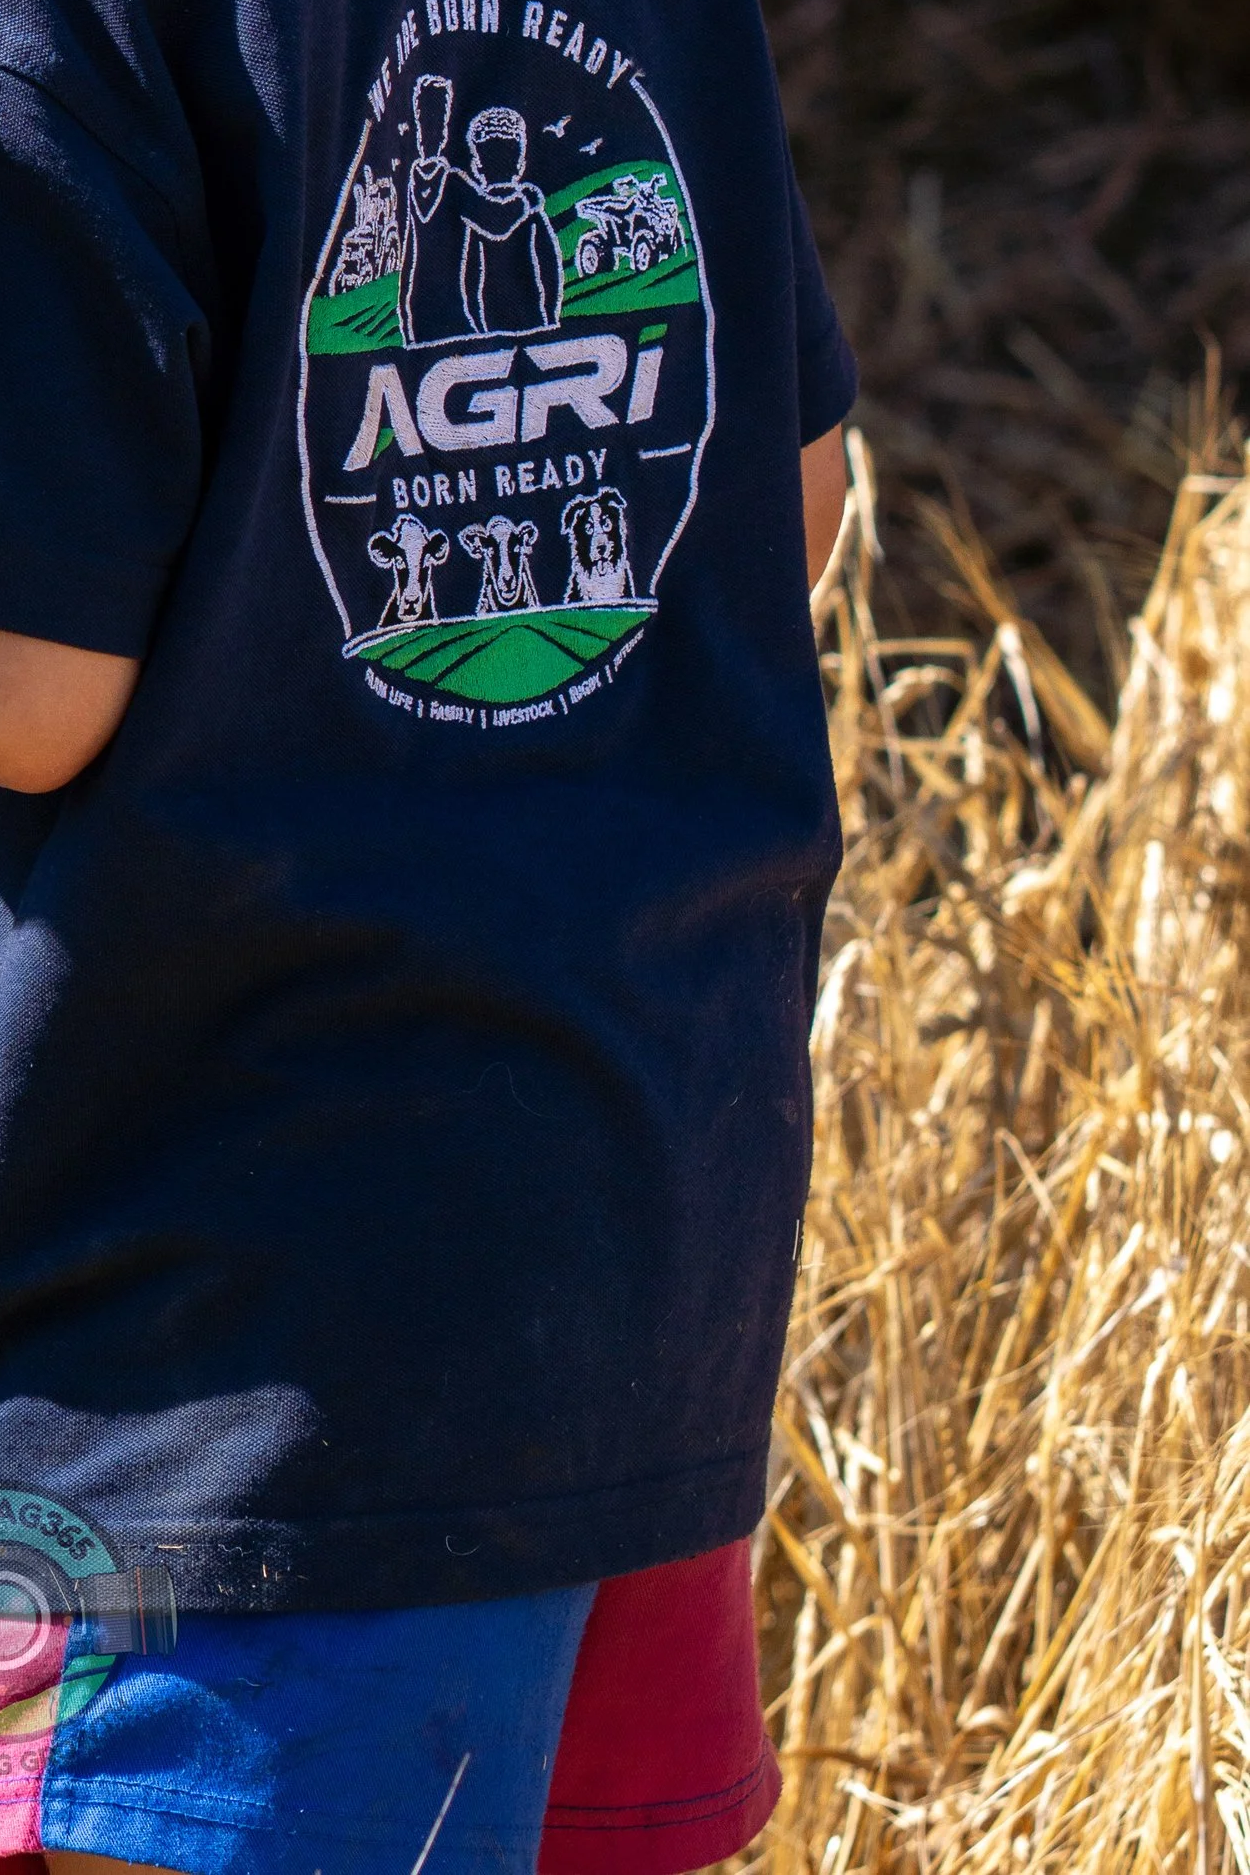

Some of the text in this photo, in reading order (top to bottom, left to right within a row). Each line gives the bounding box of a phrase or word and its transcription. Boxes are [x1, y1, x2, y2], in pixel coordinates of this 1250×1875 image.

[522, 0, 633, 89] READY
[391, 448, 608, 509] BORN READY
[388, 686, 414, 712] LIFE
[430, 701, 475, 725] FAMILY
[493, 699, 557, 727] LIVESTOCK
